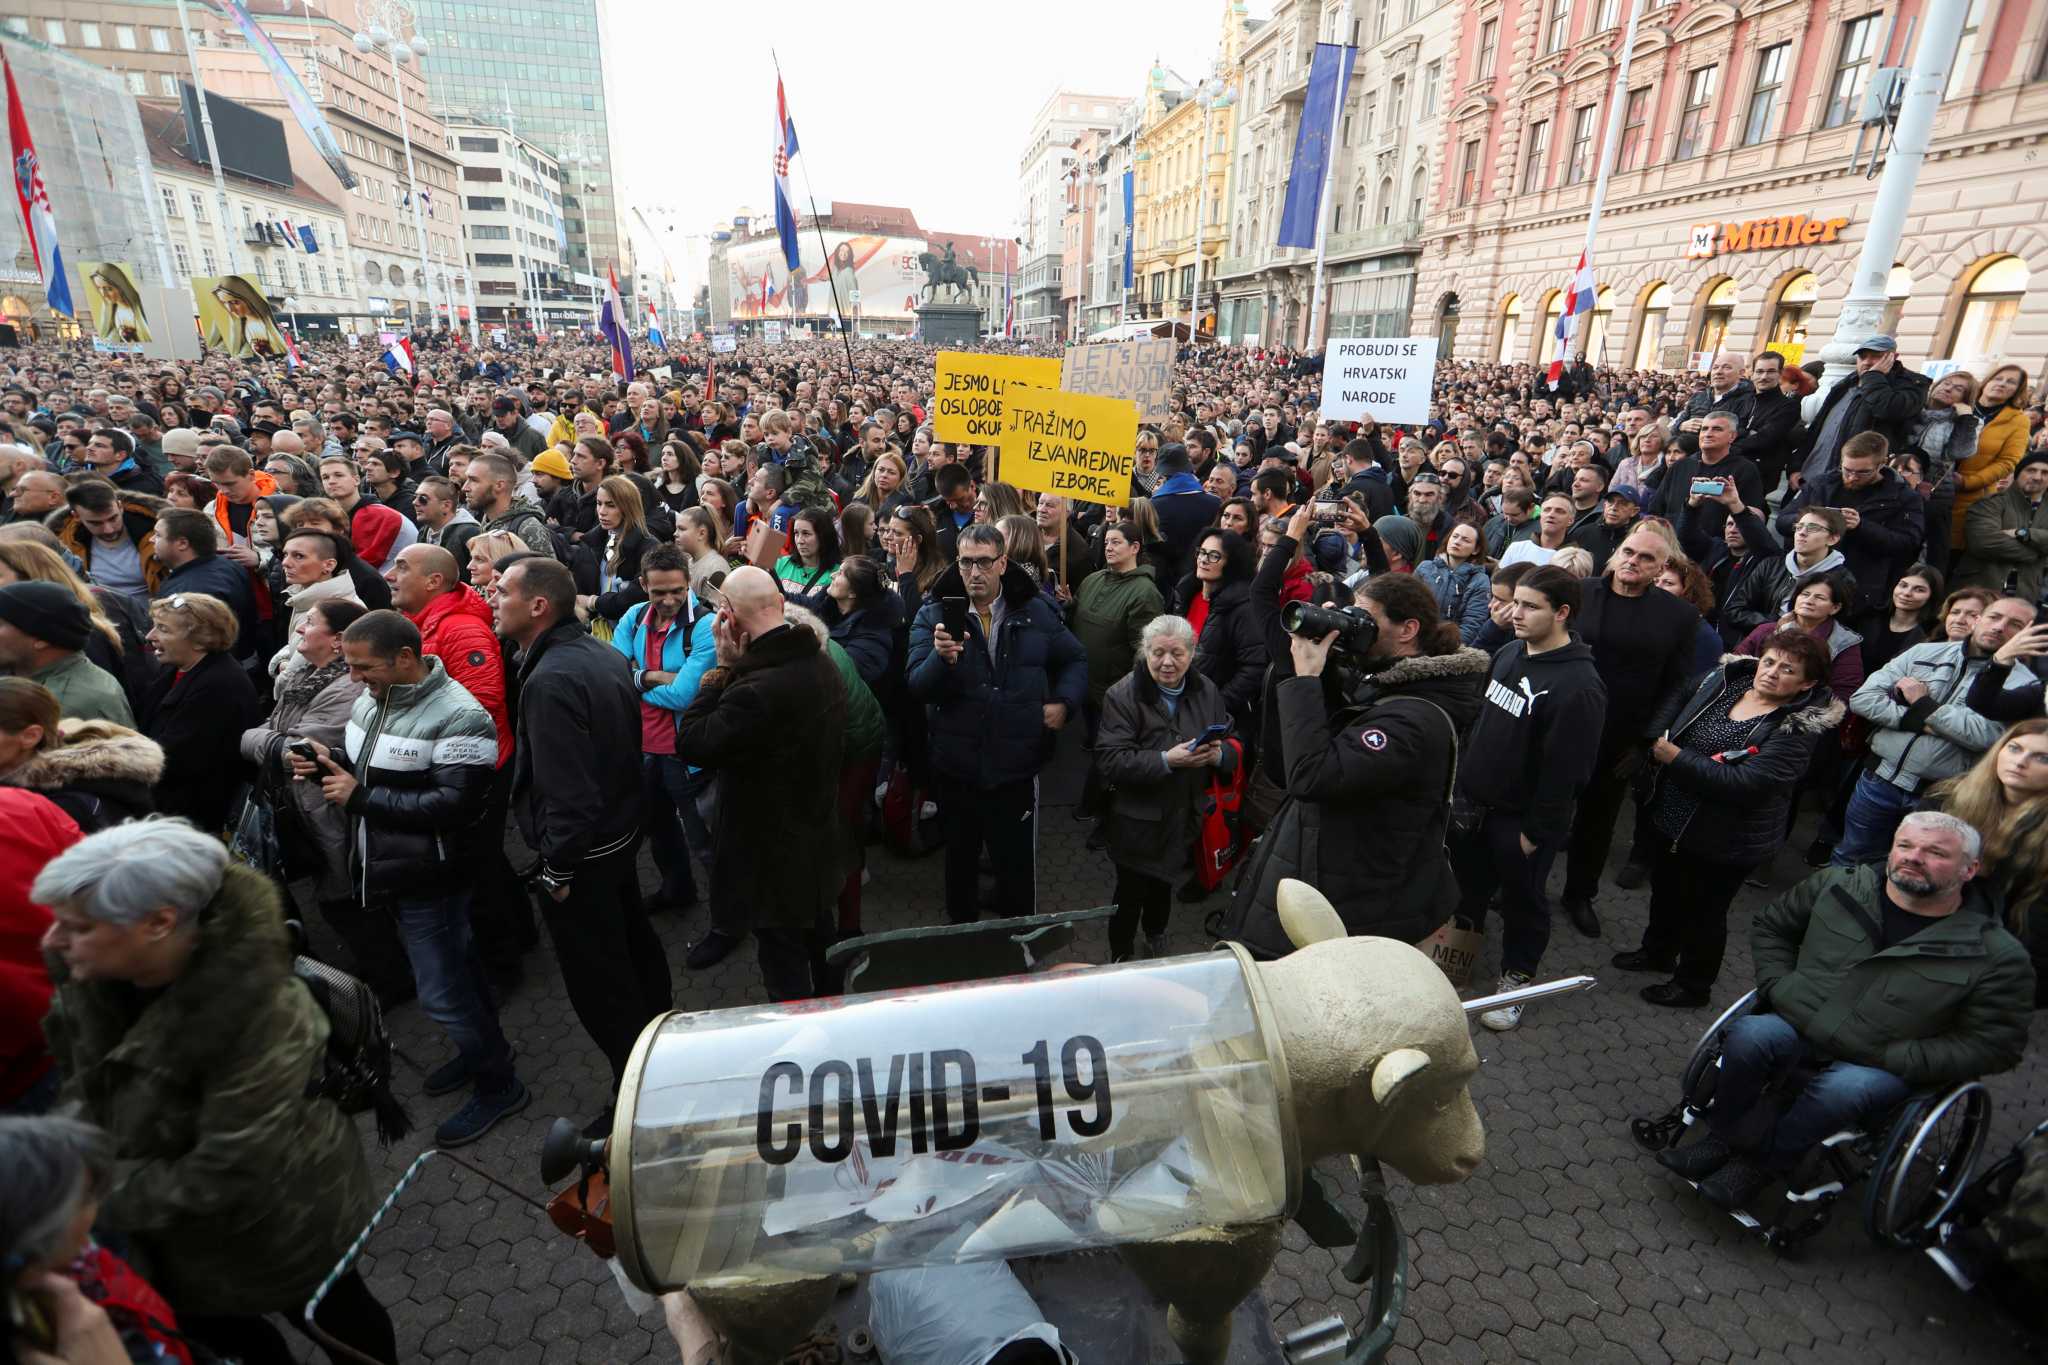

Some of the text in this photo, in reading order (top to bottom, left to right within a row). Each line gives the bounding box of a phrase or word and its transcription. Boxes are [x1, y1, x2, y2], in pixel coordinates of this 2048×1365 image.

[1719, 214, 1849, 252] Müller
[1135, 340, 1170, 365] GO
[1339, 344, 1418, 356] PROBUDI SE
[944, 373, 989, 392] JESMO
[1070, 366, 1173, 393] BRANDON
[1343, 367, 1407, 380] HRVATSKI
[1342, 390, 1396, 404] NARODE
[1028, 441, 1134, 476] IZVANREDNE
[1484, 679, 1526, 718] PUMA
[389, 747, 418, 758] WEAR
[1432, 944, 1475, 968] MENI
[757, 1035, 1113, 1166] COVID-19
